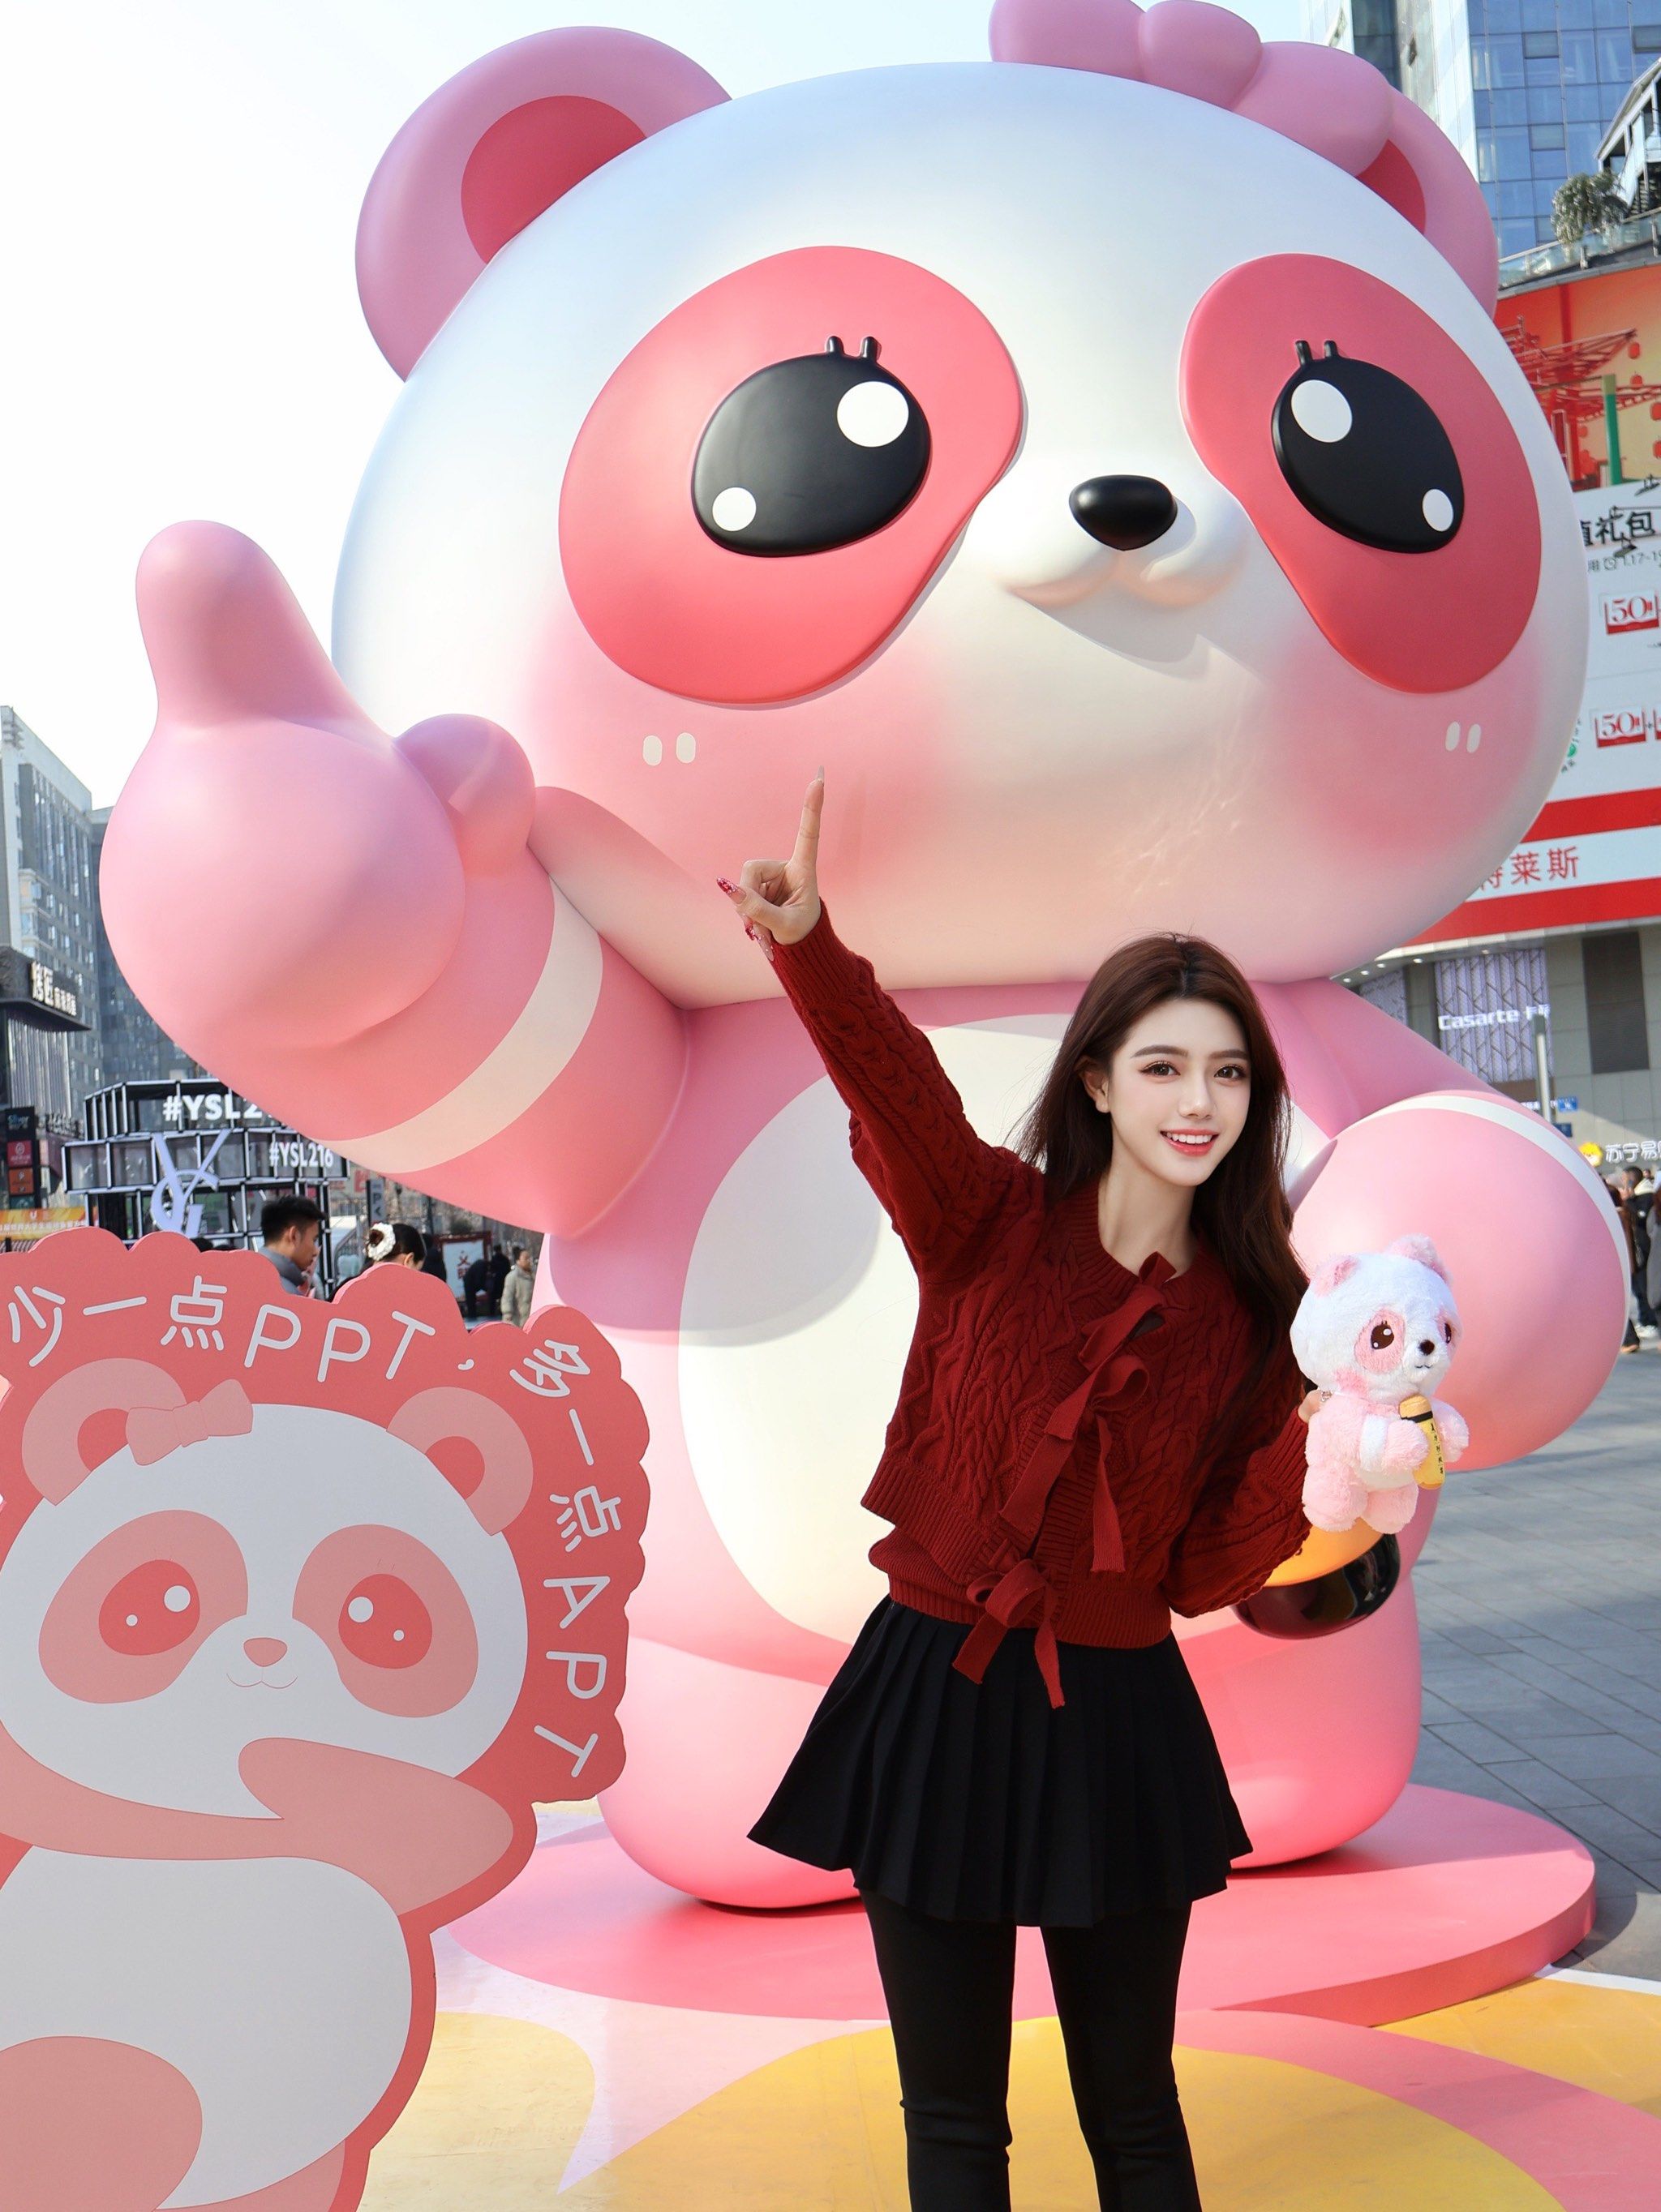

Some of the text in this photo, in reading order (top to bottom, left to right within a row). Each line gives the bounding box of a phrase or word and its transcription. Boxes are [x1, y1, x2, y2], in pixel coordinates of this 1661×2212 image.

[1438, 1010, 1520, 1031] Casarte
[268, 1142, 334, 1168] #YSL216
[1605, 1140, 1661, 1164] 苏宁易
